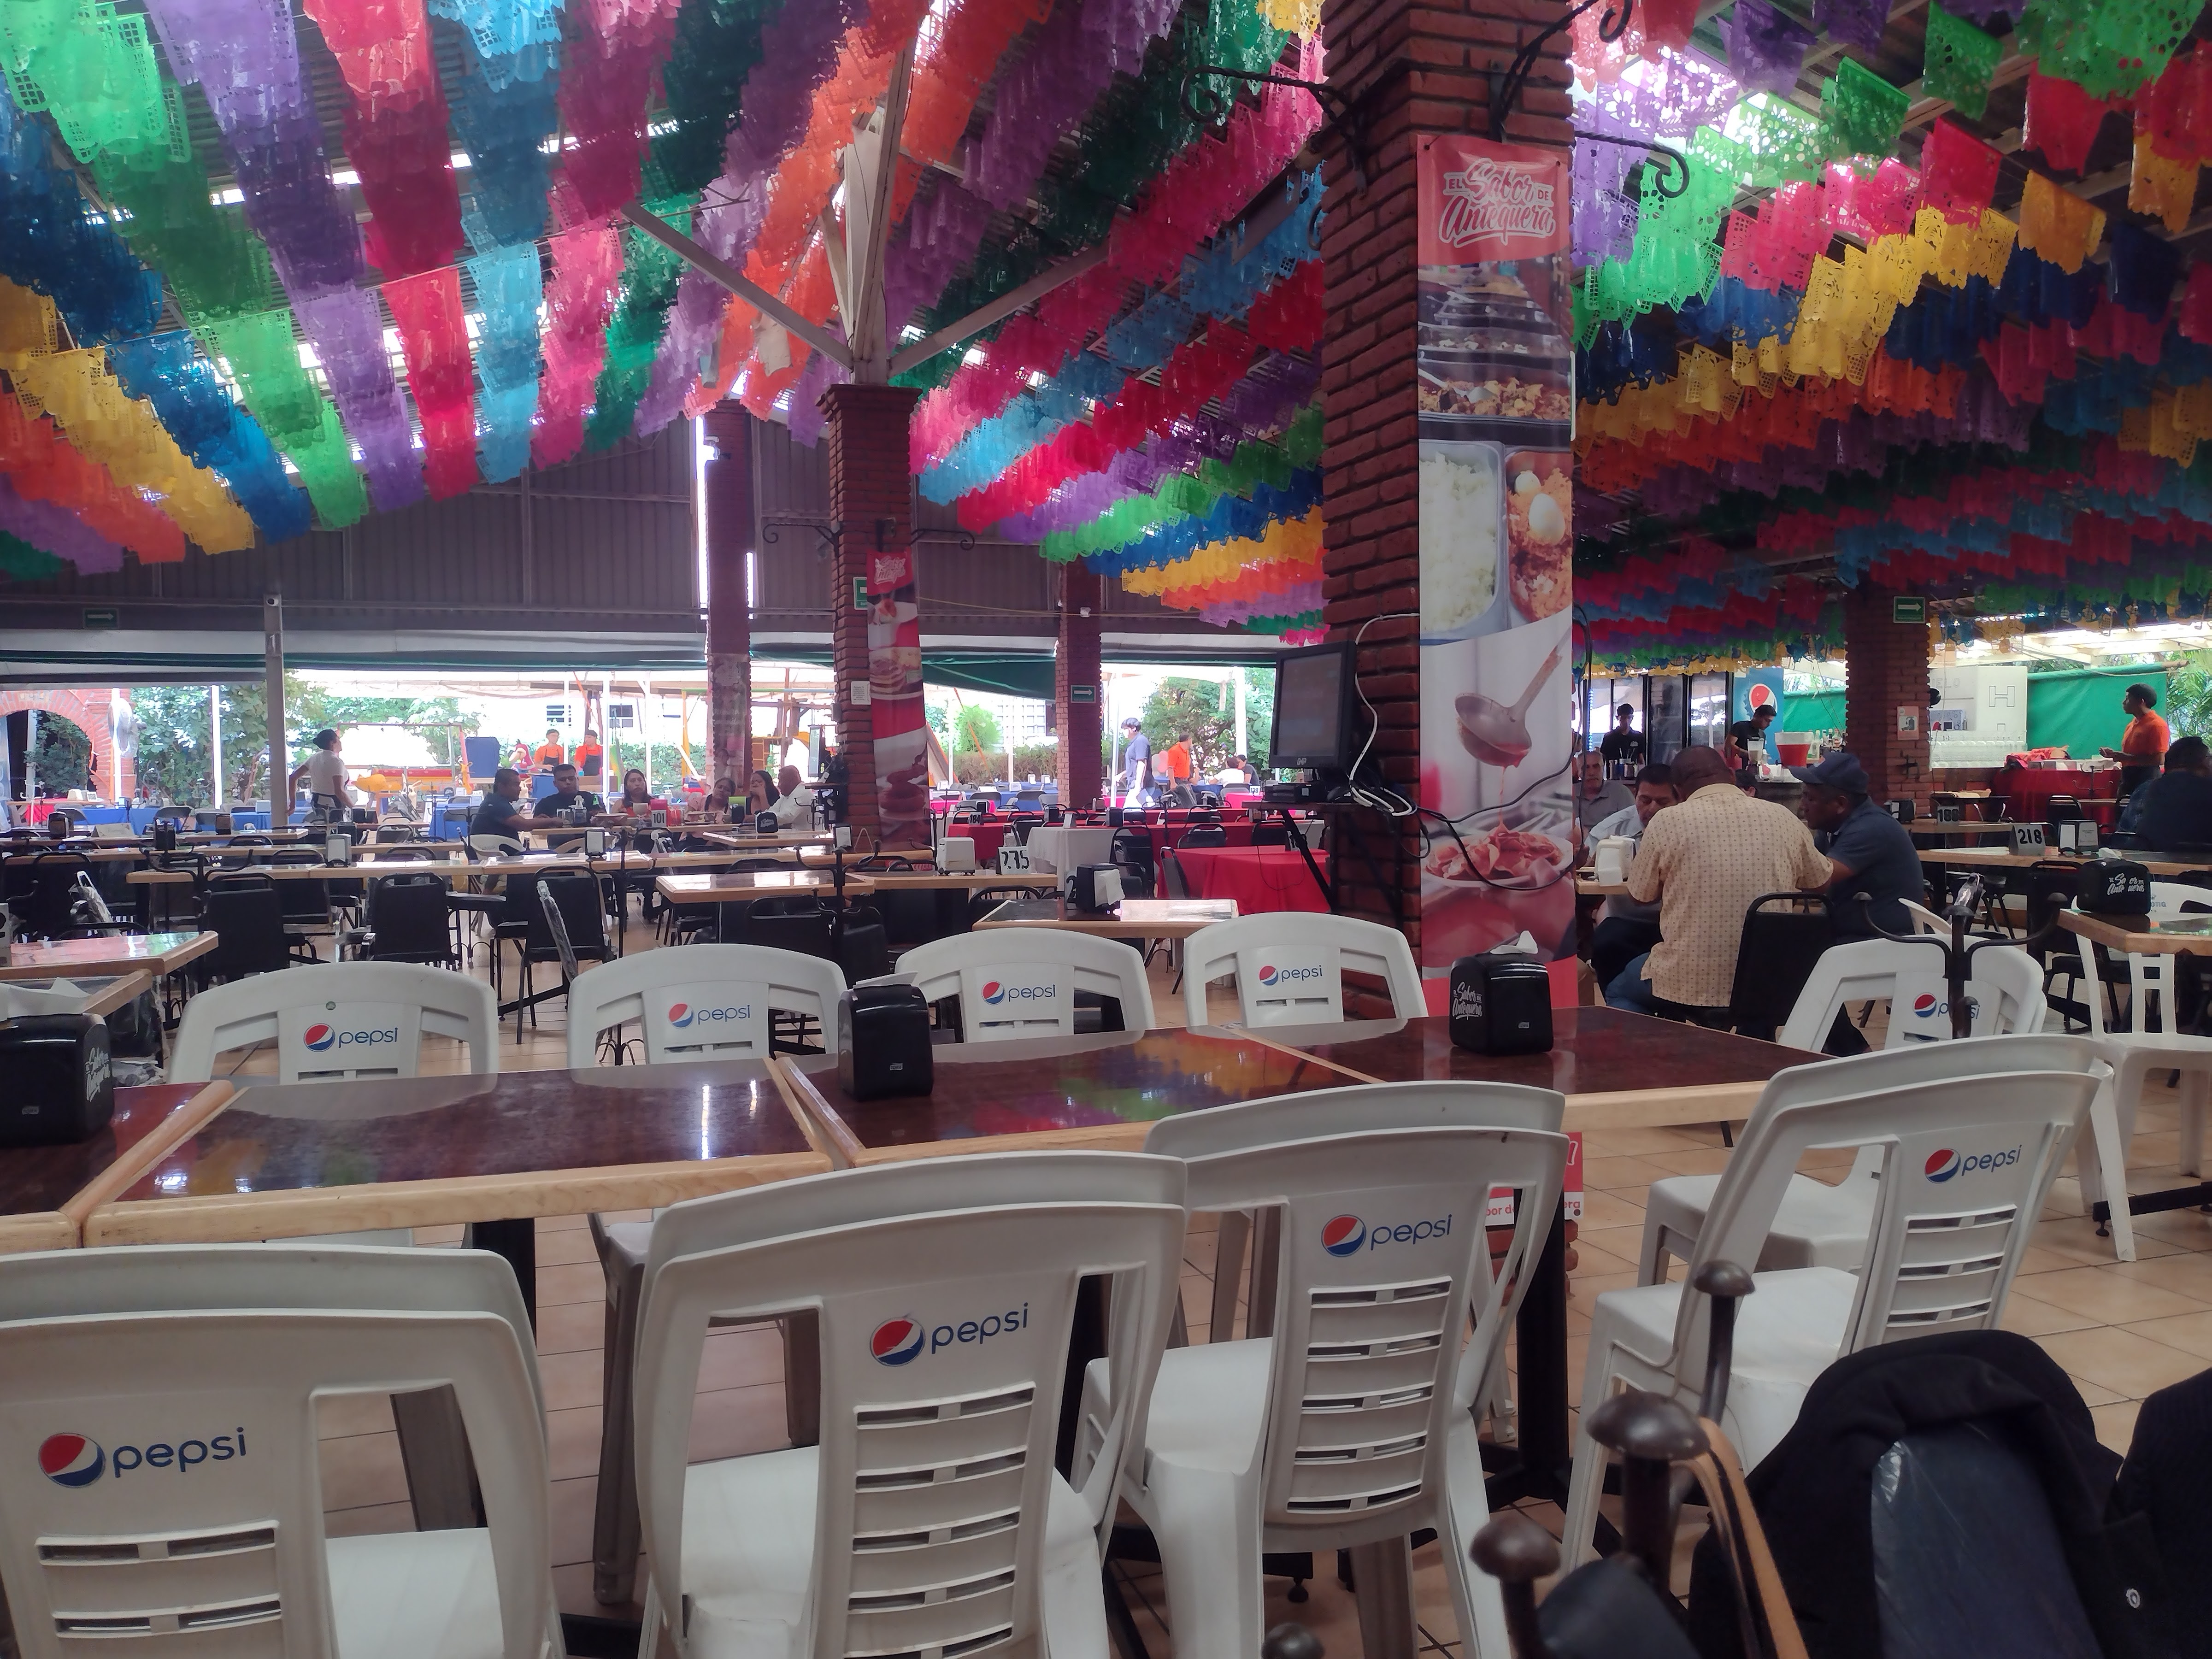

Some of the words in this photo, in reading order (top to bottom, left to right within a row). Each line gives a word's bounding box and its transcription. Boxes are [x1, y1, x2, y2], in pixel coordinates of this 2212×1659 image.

[1448, 178, 1463, 189] EL
[1465, 159, 1535, 203] Sabor
[1537, 189, 1549, 201] DE
[1441, 195, 1555, 243] Antequera
[653, 812, 665, 824] 101
[970, 814, 981, 824] 184
[2018, 828, 2043, 845] 218
[1281, 965, 1323, 982] pepsi
[1008, 983, 1056, 1002] pepsi
[698, 1004, 750, 1025] pepsi
[1938, 1002, 1981, 1019] psi
[338, 1026, 398, 1049] pepsi
[1961, 1145, 2022, 1177] pepsi
[1371, 1213, 1452, 1252] pepsi
[931, 1301, 1029, 1355] pepsi
[112, 1426, 247, 1479] pepsi
